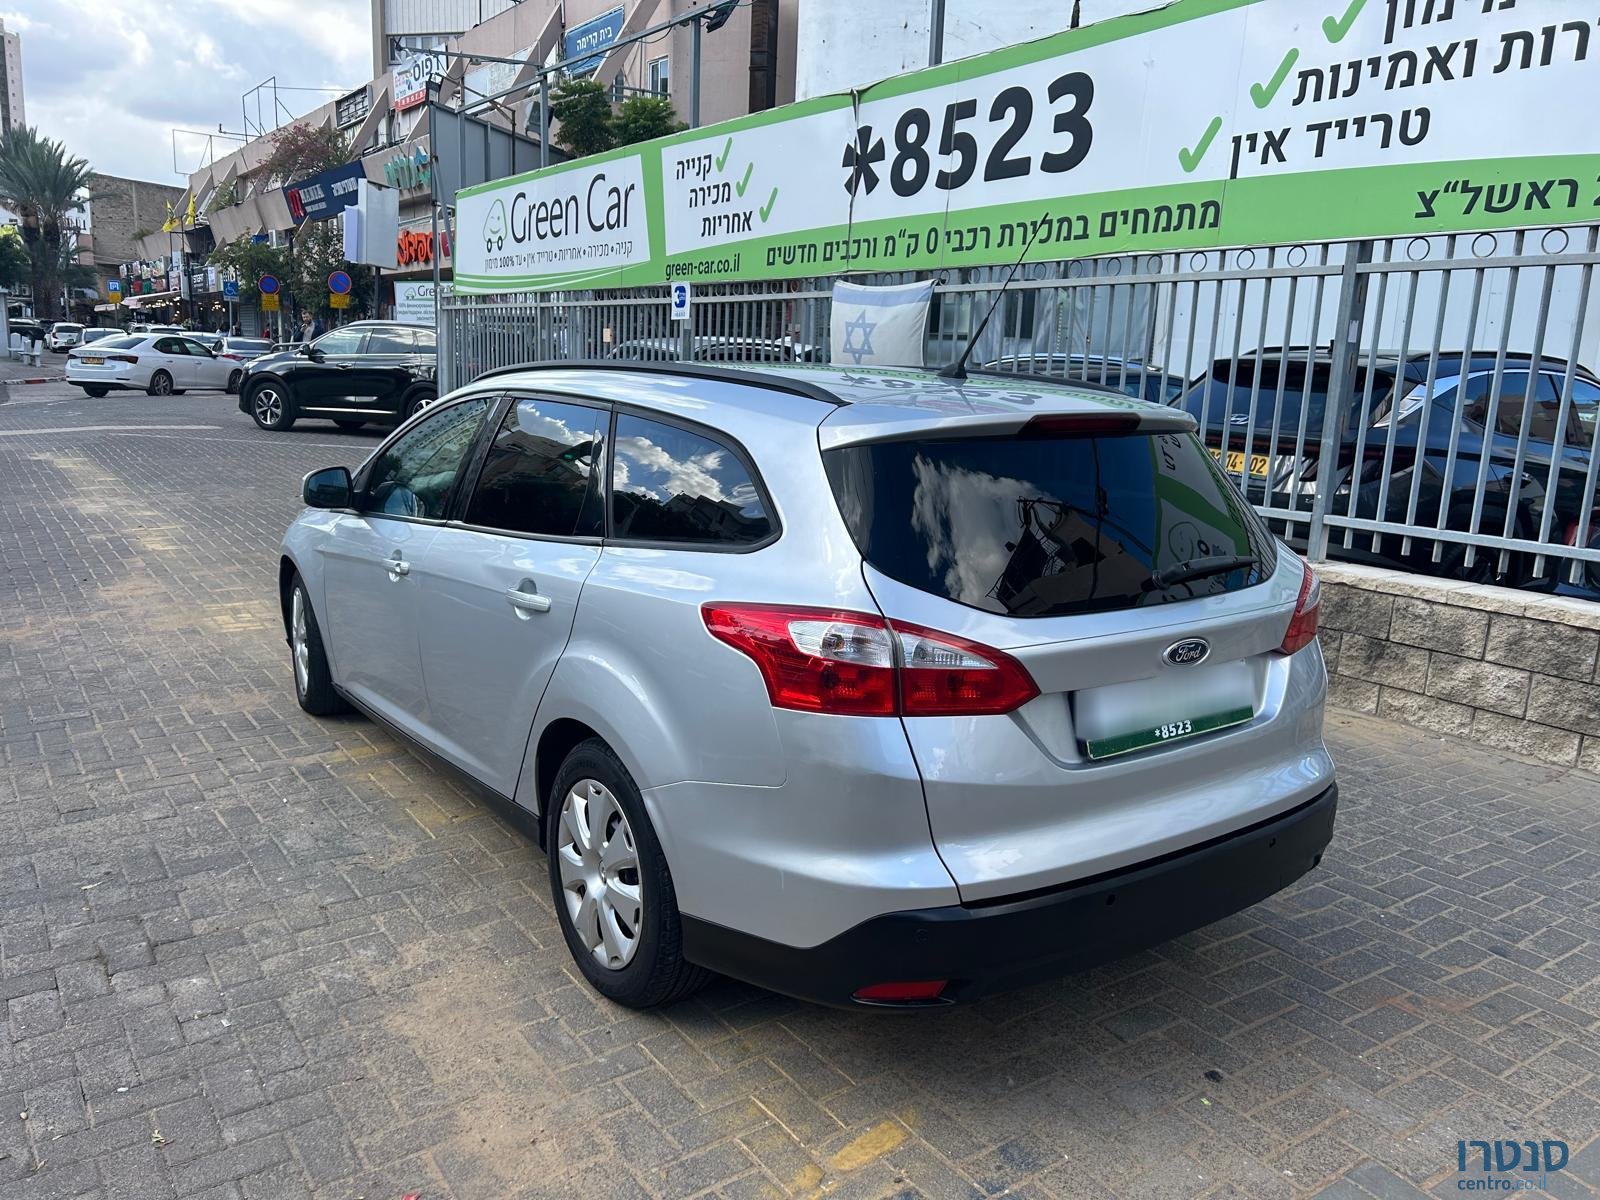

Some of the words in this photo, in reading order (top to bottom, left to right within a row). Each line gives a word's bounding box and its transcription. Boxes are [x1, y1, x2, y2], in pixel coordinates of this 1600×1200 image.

[577, 33, 597, 51] קדימה
[600, 27, 612, 40] בית
[1493, 17, 1600, 74] רות
[1292, 38, 1478, 106] ואמינות
[1306, 107, 1431, 158] טרייד
[1229, 127, 1292, 180] אין
[677, 153, 713, 181] קנייה
[689, 182, 731, 208] מכירה
[511, 191, 579, 244] Green
[586, 173, 636, 233] Car
[1099, 199, 1221, 237] מתמחים
[701, 210, 752, 238] אחריות
[999, 213, 1089, 247] במכירת
[587, 243, 609, 259] מכירה
[616, 240, 633, 258] קניה
[823, 235, 878, 262] ורכבים
[926, 227, 939, 254] 0
[945, 224, 990, 253] רכבי
[499, 256, 515, 268] 100%
[515, 253, 522, 266] עד
[526, 252, 536, 268] אין
[537, 250, 553, 263] טרייד
[558, 246, 582, 262] אחריות
[665, 253, 741, 281] green-car.co.il
[766, 242, 818, 267] חדשים
[417, 285, 435, 297] Gre
[1175, 643, 1202, 662] Ford
